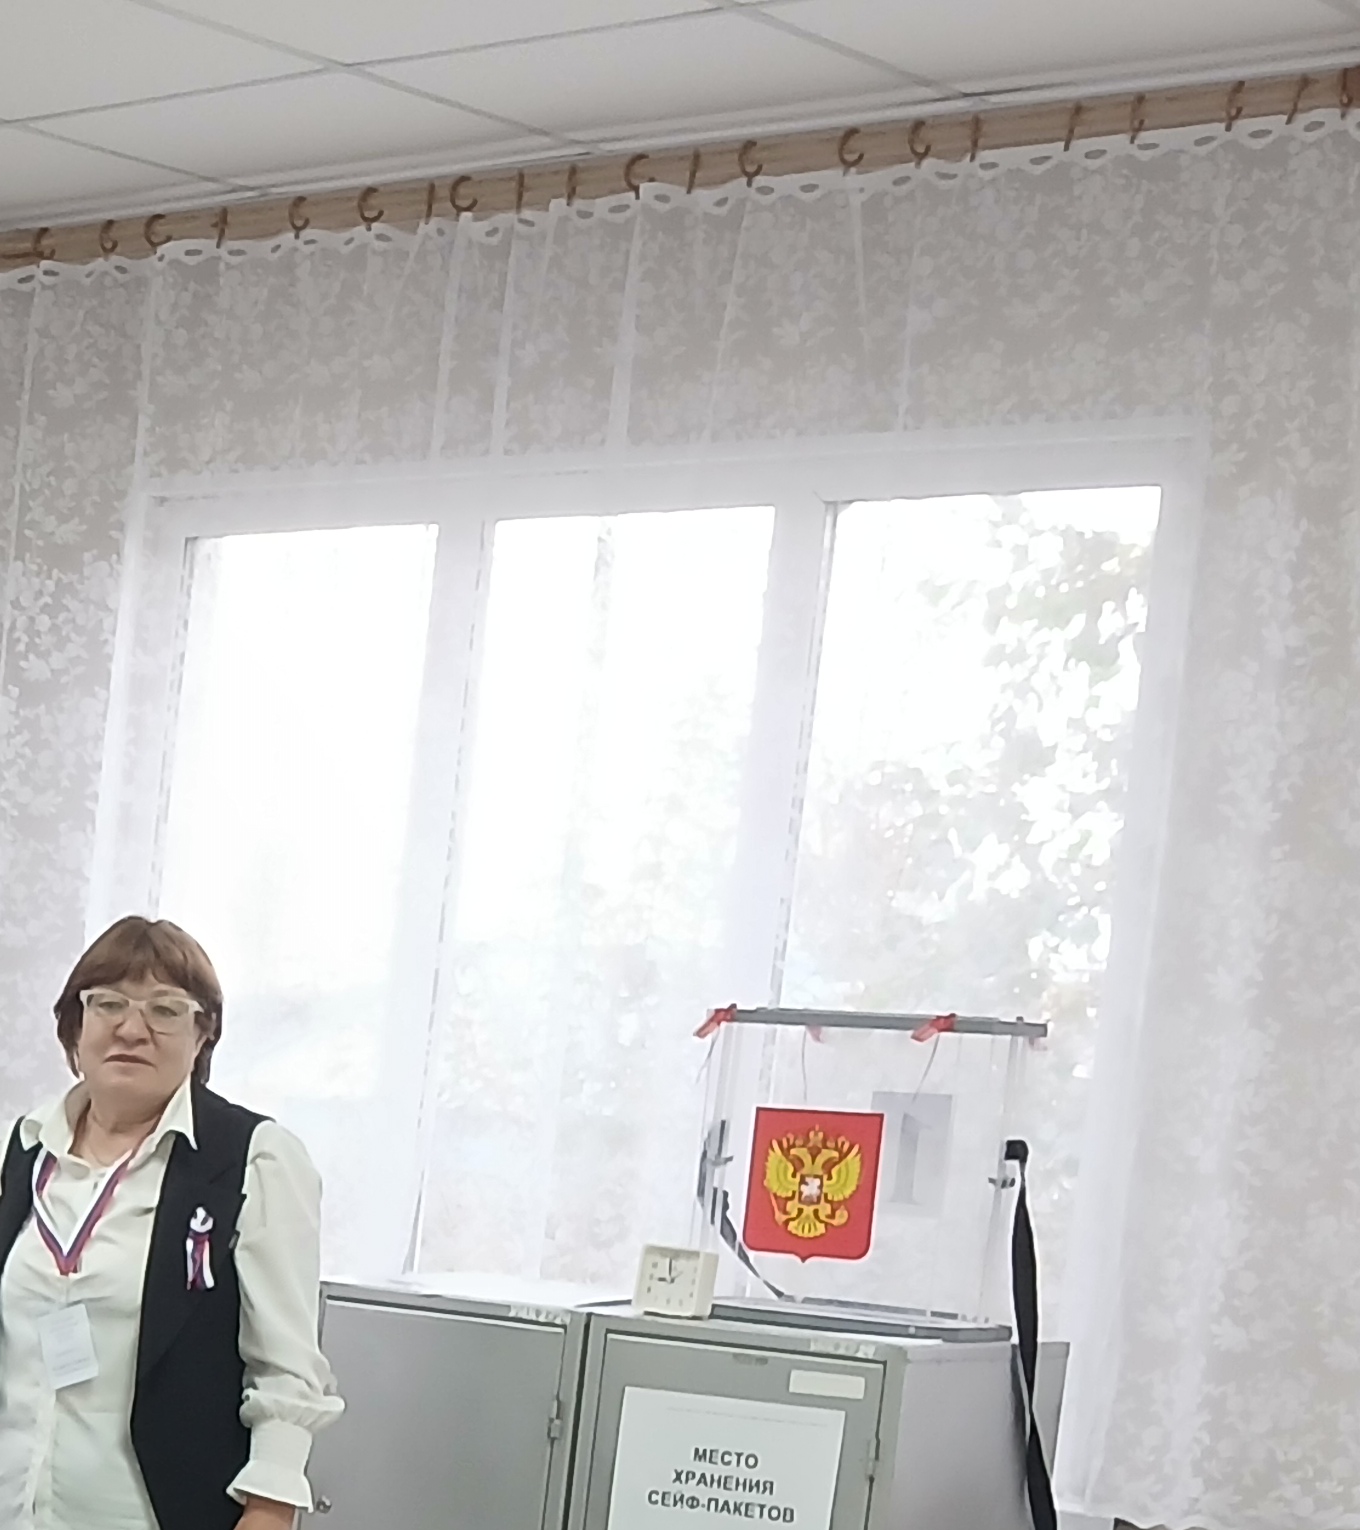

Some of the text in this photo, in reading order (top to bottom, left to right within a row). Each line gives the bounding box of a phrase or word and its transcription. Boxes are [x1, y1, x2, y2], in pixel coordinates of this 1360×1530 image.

[692, 1446, 759, 1470] МЕСТО
[671, 1468, 775, 1496] ХРАНЕНИЯ
[647, 1489, 796, 1524] СЕЙФ-ПАКЕТОВ
